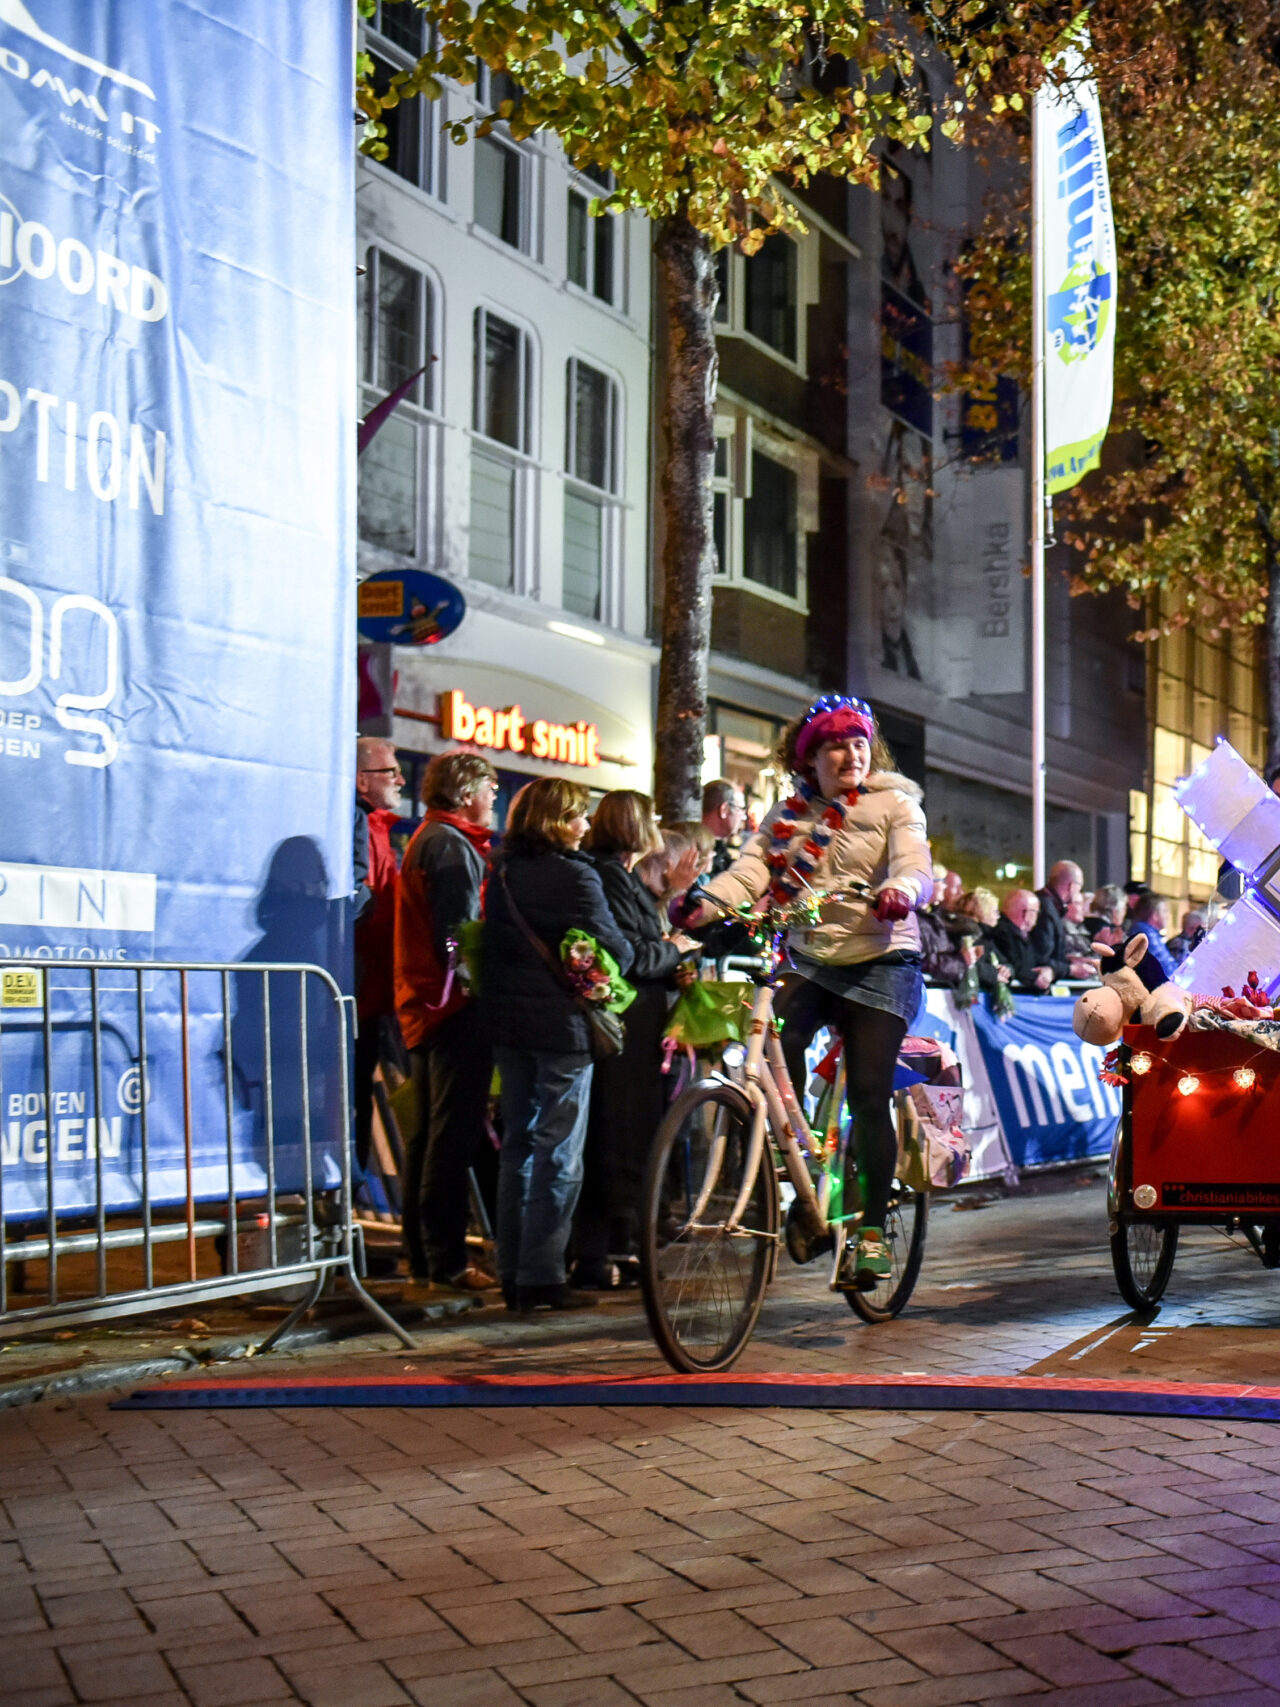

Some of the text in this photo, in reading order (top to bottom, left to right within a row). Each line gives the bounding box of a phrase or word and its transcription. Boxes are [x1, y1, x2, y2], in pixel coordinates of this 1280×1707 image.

[980, 522, 1010, 639] Bershka
[451, 689, 599, 767] bart smit
